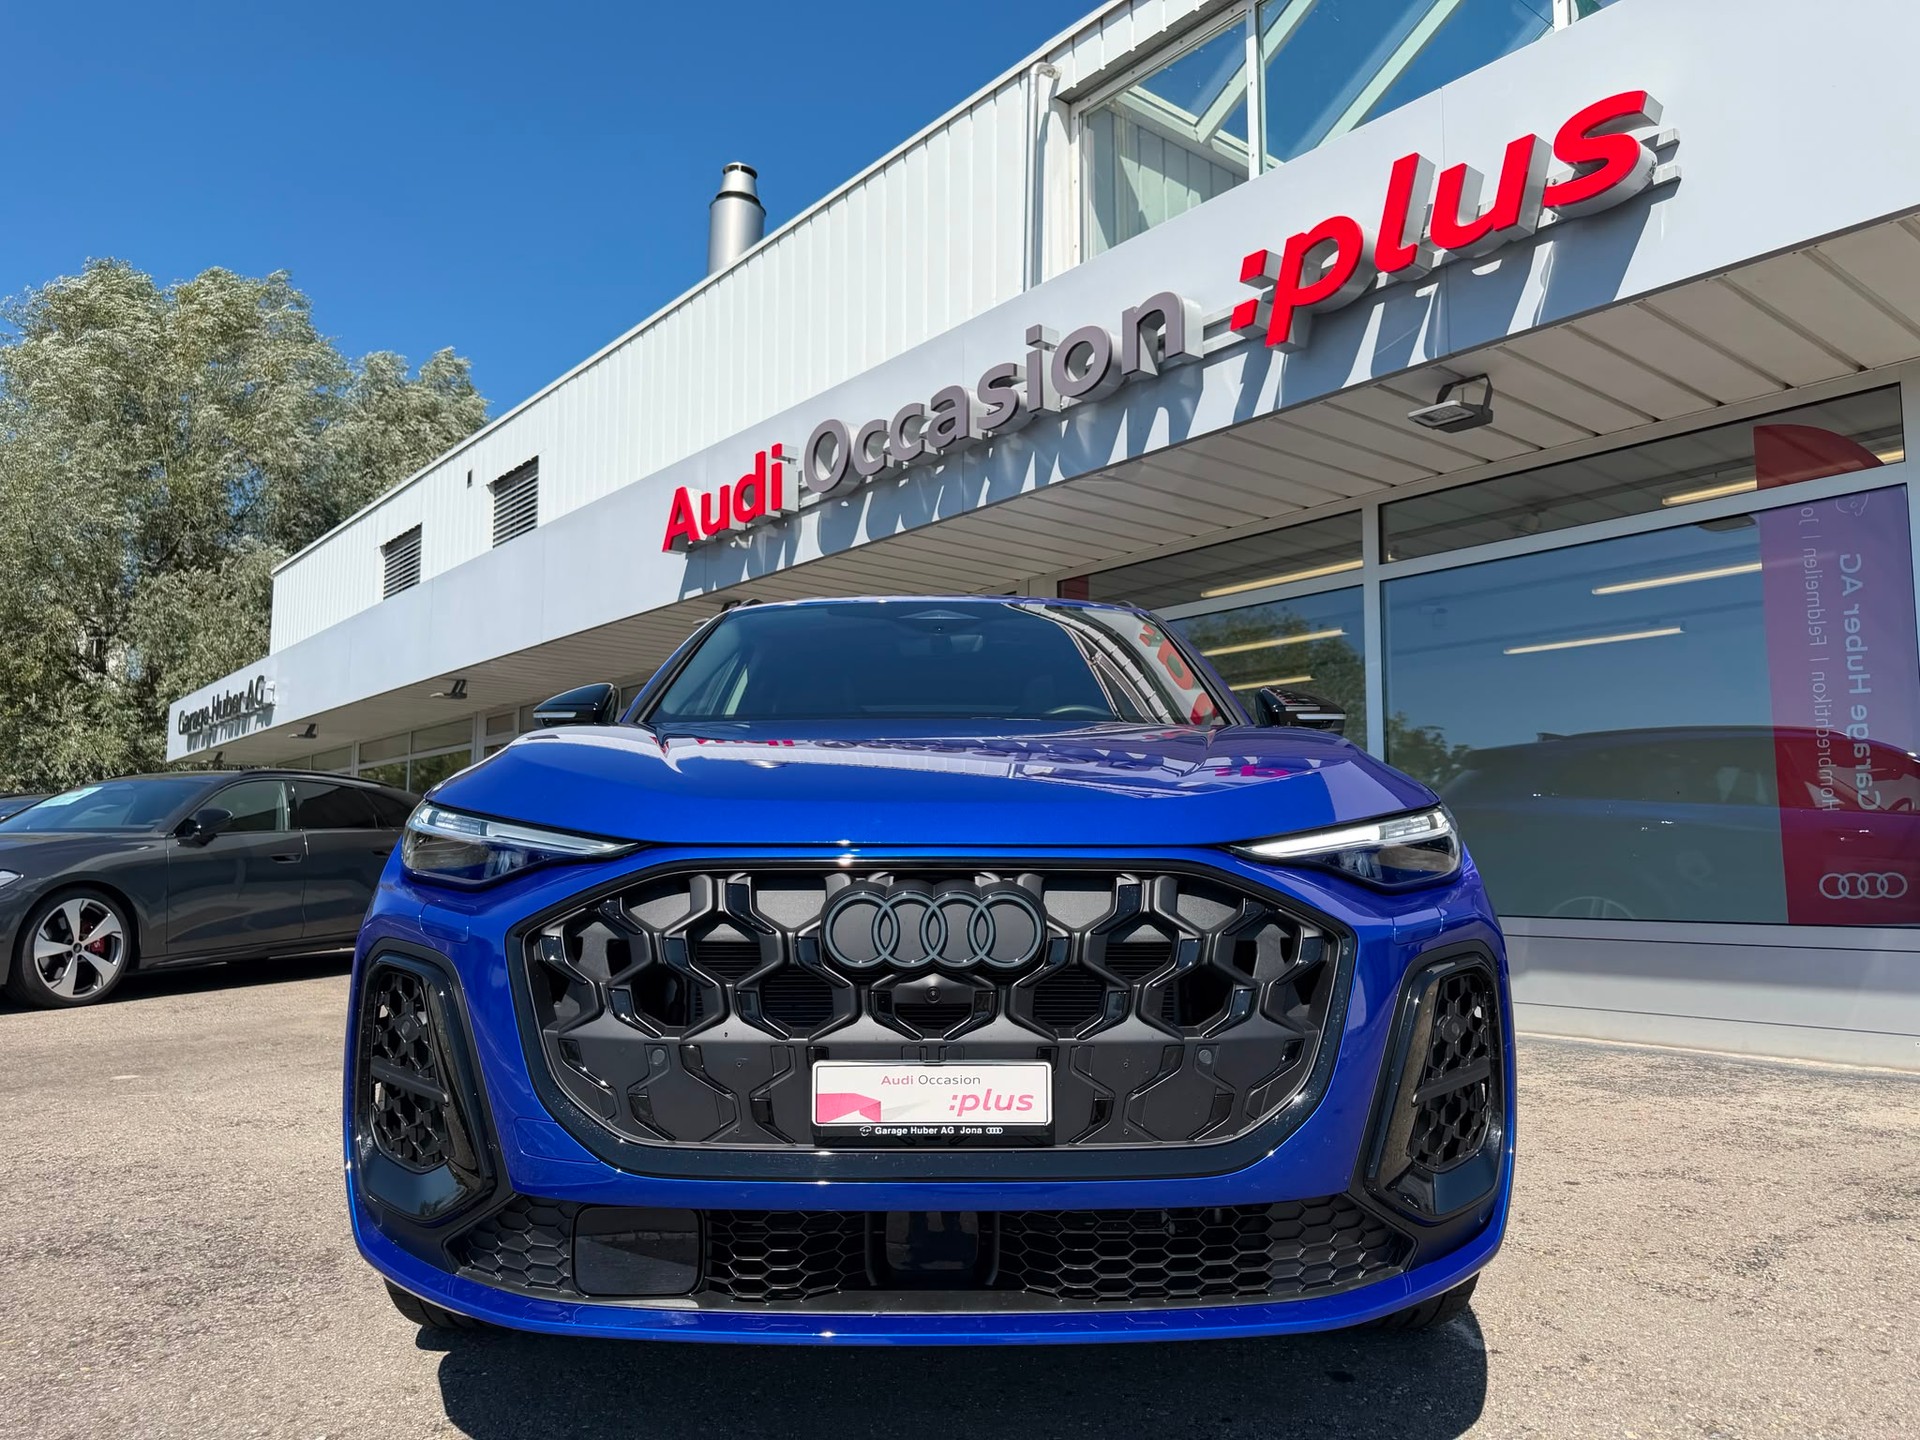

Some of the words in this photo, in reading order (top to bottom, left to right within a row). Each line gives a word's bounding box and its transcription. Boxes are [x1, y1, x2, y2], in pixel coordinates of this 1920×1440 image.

[662, 443, 785, 552] Audi
[803, 290, 1192, 493] Occasion
[1230, 90, 1652, 347] :plus
[178, 706, 211, 736] Garage
[211, 689, 245, 723] Huber
[244, 675, 267, 711] AG
[881, 1074, 914, 1086] Audi
[918, 1074, 981, 1086] Occasion
[949, 1088, 1034, 1117] :plus
[874, 1126, 907, 1136] Garage
[910, 1125, 938, 1135] Huber
[940, 1126, 955, 1135] AG
[960, 1126, 983, 1135] Jona
